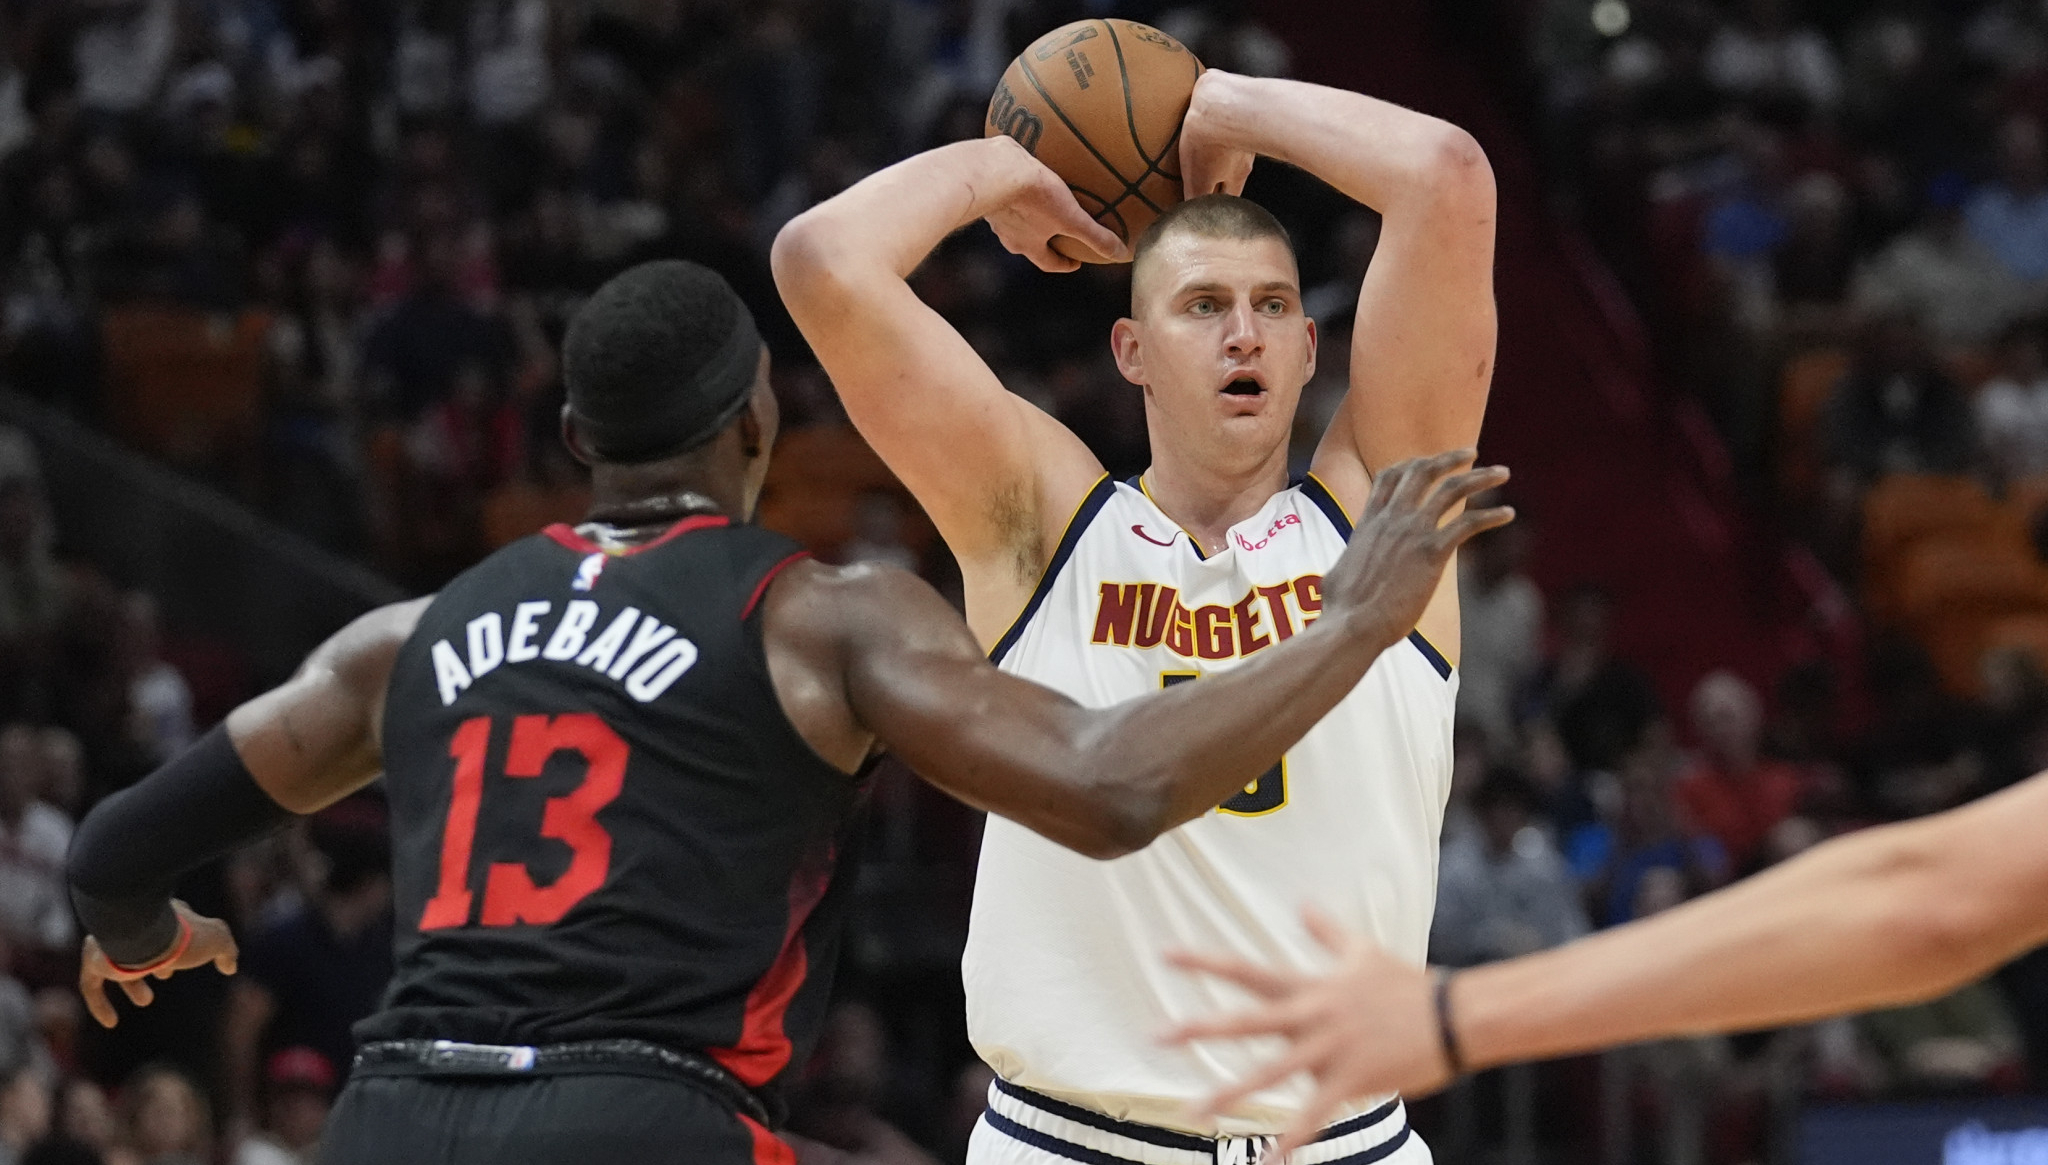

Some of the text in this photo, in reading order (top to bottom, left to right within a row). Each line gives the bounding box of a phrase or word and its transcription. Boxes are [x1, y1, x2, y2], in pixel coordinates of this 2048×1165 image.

[1233, 513, 1301, 551] ibotta
[431, 600, 698, 706] ADEBAYO
[1090, 573, 1324, 660] NUGGETS
[418, 712, 630, 931] 13
